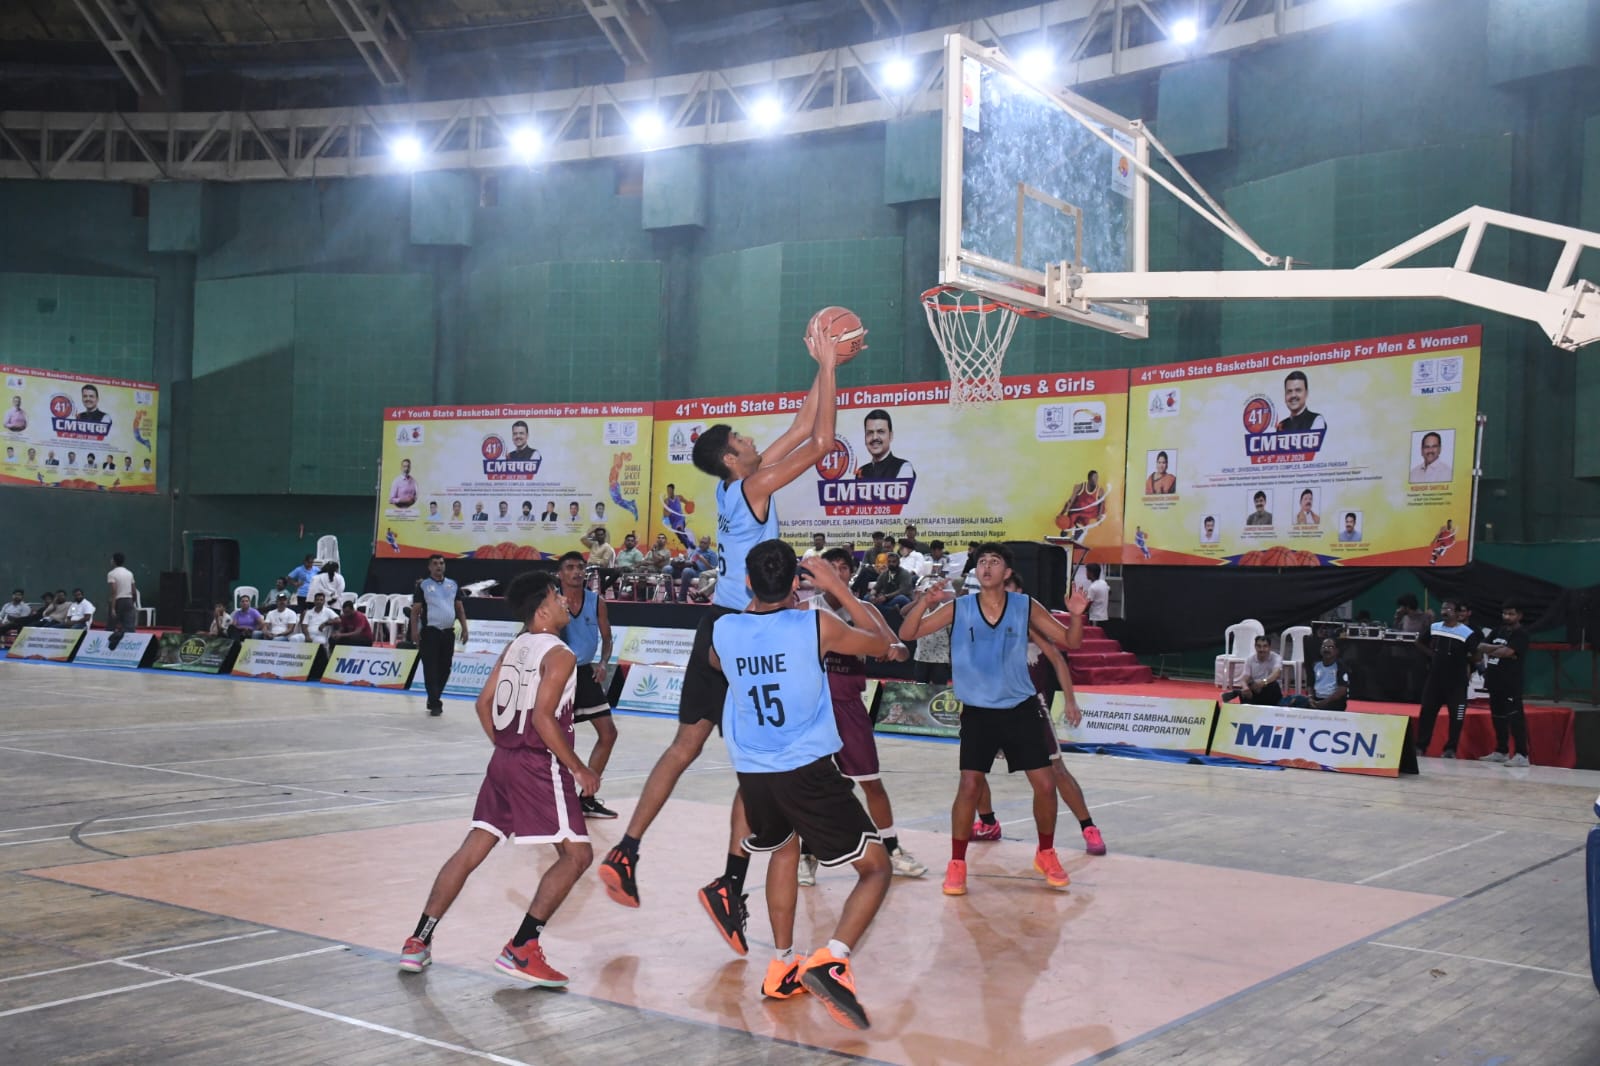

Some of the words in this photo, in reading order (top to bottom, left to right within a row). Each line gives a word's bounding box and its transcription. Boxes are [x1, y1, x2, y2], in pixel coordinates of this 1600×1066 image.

[1160, 367, 1185, 380] Youth
[1188, 364, 1213, 377] State
[1215, 357, 1269, 373] Basketball
[1272, 347, 1351, 367] Championship
[1354, 345, 1375, 357] For
[1377, 341, 1403, 354] Men
[1407, 338, 1417, 350] &
[1420, 334, 1468, 349] Women
[701, 401, 737, 416] Youth
[741, 399, 775, 413] State
[779, 393, 849, 411] Basall
[854, 386, 953, 408] Championshi
[997, 382, 1032, 398] oys
[1037, 379, 1049, 392] &
[1055, 377, 1095, 392] Girls
[408, 409, 430, 418] Youth
[433, 409, 455, 417] State
[456, 408, 500, 417] Basketball
[502, 407, 562, 417] Championship
[564, 406, 578, 415] For
[581, 406, 598, 414] Men
[601, 406, 608, 414] &
[611, 405, 643, 414] Women
[856, 505, 872, 515] JULY
[791, 519, 813, 527] SPORTS
[843, 518, 874, 526] GARKHEDA
[904, 517, 946, 525] CHHATRAPATI
[947, 516, 979, 524] SAMBHAJI
[980, 516, 1003, 524] NAGAR
[961, 528, 988, 537] Sambhaji
[989, 529, 1007, 538] Nagar
[969, 626, 975, 643] 1
[369, 660, 401, 677] CSN
[452, 661, 492, 675] Manida
[736, 653, 786, 676] PUNE
[748, 683, 785, 728] 15
[1132, 713, 1206, 726] SAMBHAJINAGAR
[1085, 720, 1129, 732] MUNICIPAL
[1131, 724, 1191, 736] CORPORATION
[1308, 729, 1378, 758] CSN
